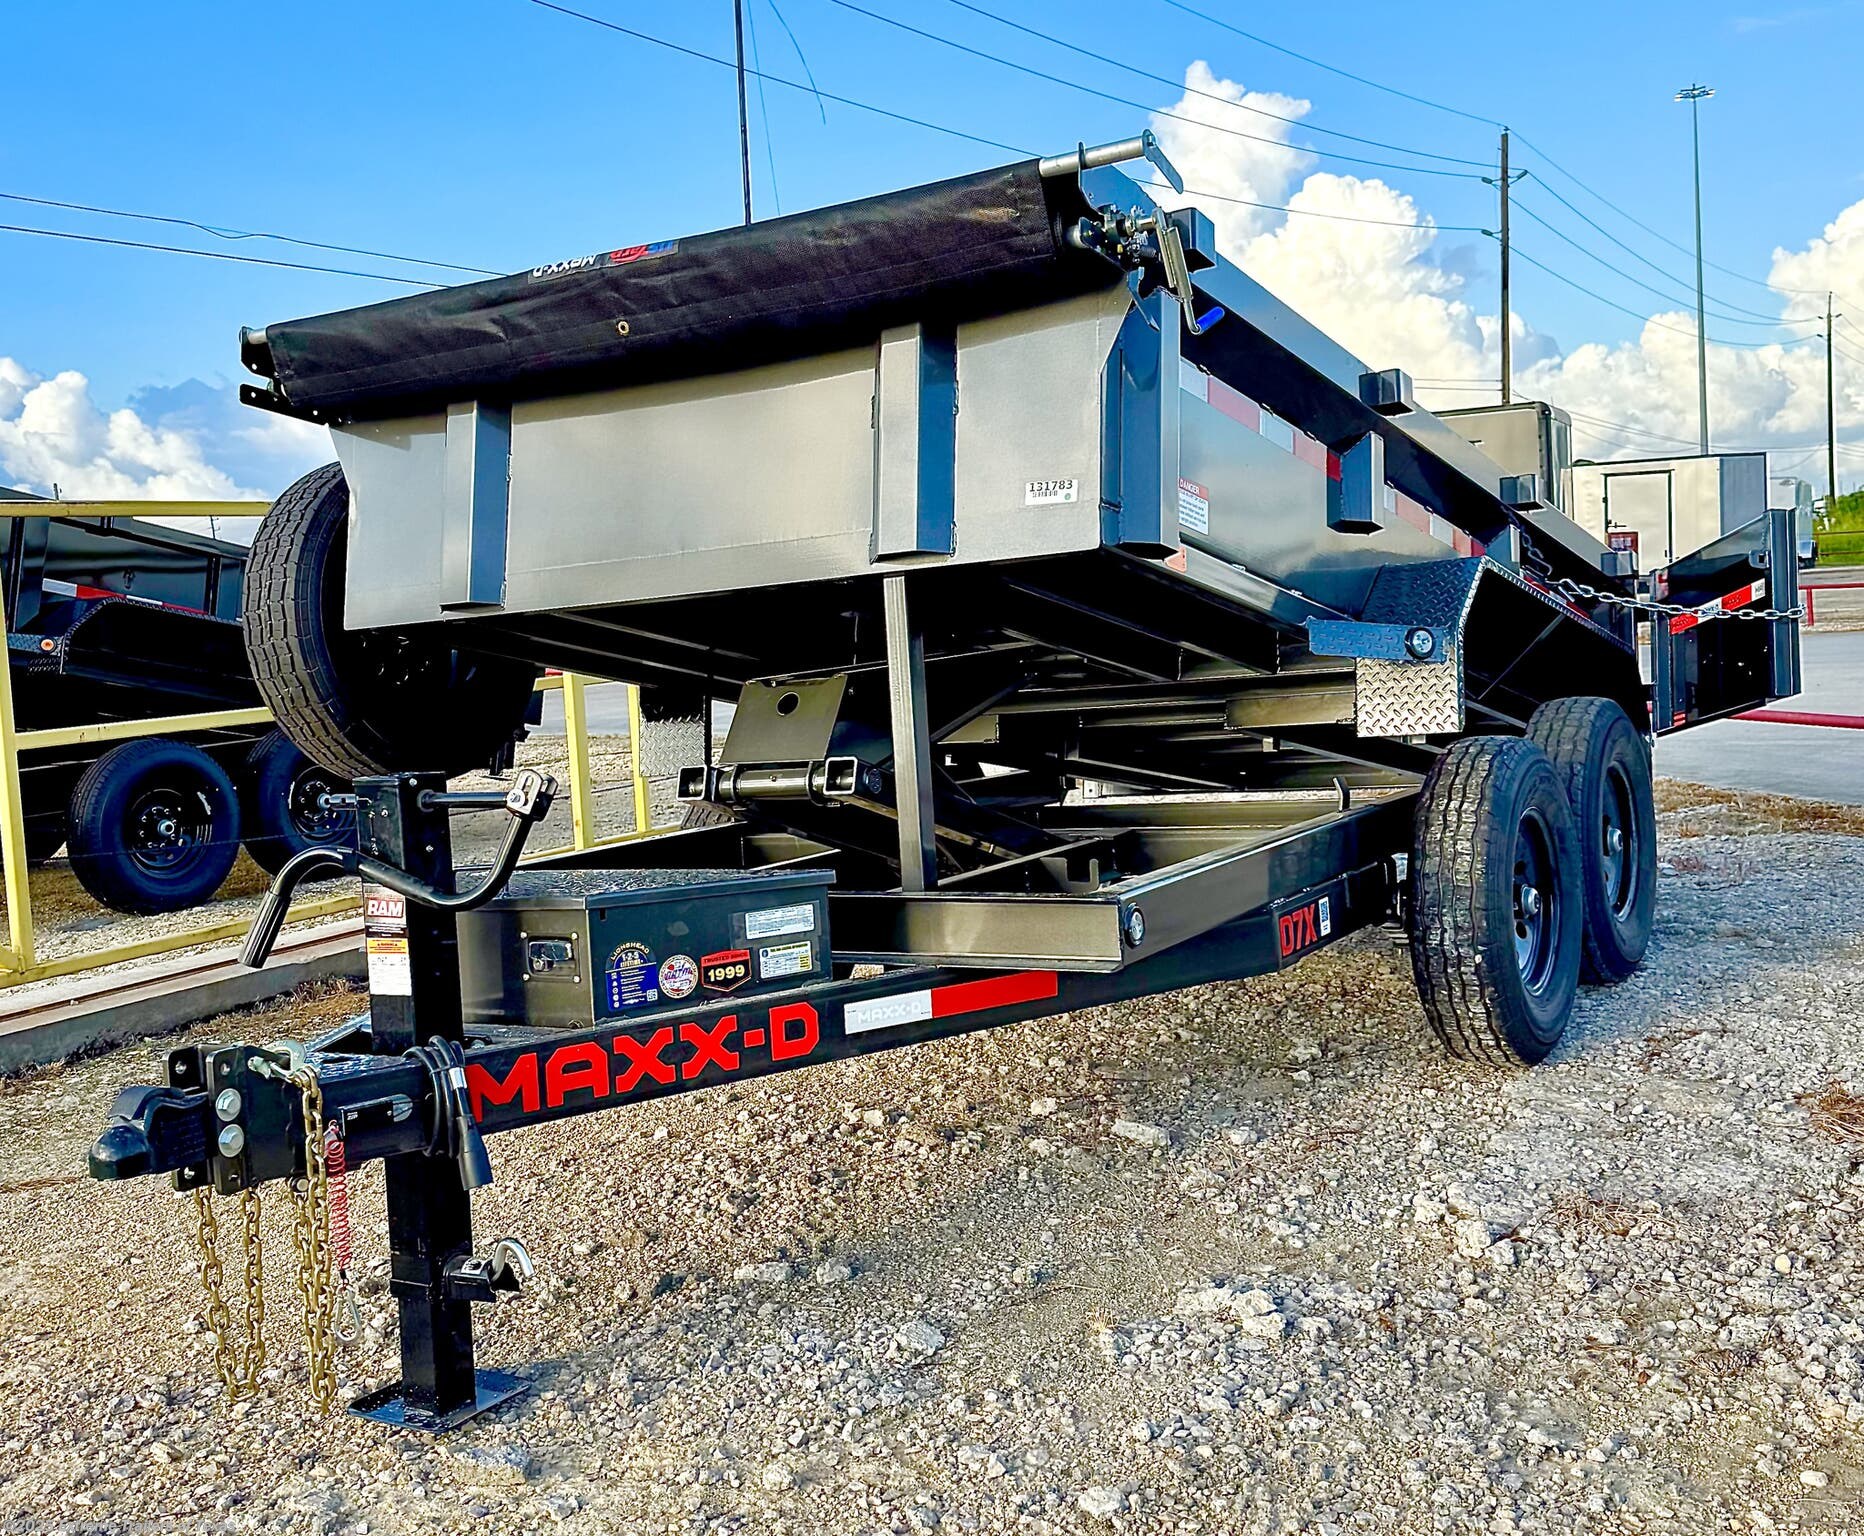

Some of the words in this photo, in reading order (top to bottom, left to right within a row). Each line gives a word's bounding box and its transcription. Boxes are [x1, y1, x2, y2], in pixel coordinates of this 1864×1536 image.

[1029, 479, 1073, 492] 131783
[1180, 478, 1200, 495] DANGER
[367, 900, 404, 917] RAM
[610, 942, 650, 961] LIONSHEAD
[708, 964, 745, 982] 1999
[857, 1001, 921, 1024] MAXX-D
[464, 1001, 820, 1123] MAXX-D
